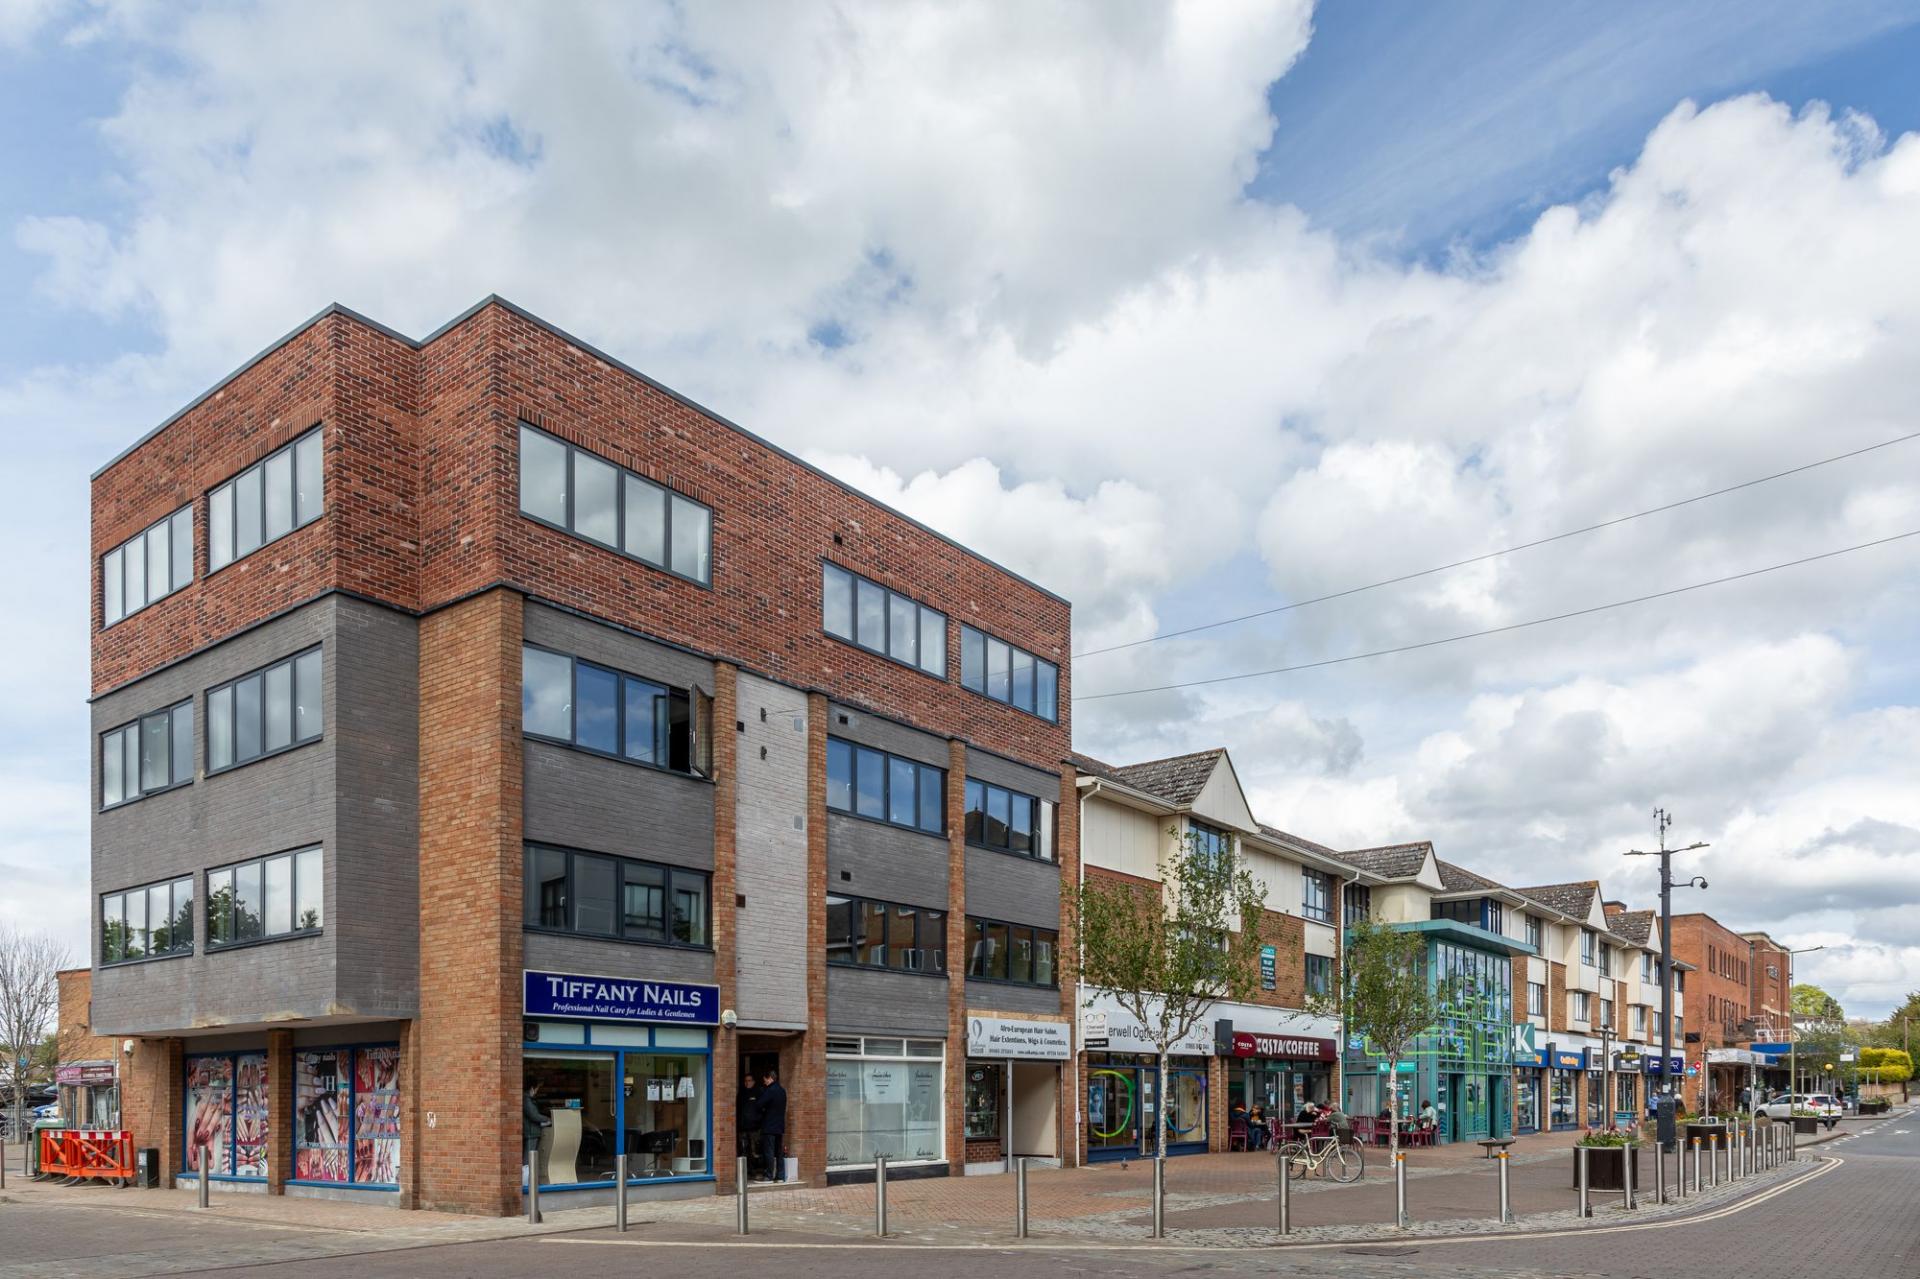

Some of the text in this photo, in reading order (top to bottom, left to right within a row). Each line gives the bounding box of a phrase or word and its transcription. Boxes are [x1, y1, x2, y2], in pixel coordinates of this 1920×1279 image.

[546, 977, 702, 1007] TIFFANY NAILS
[552, 1002, 695, 1018] Professional Nail Care for Ladies & Gentlemen
[1000, 1025, 1033, 1034] Afro-European
[1108, 1025, 1132, 1038] erwell
[990, 1034, 1000, 1042] Hair
[1028, 1037, 1039, 1046] Wigs
[1256, 1038, 1320, 1056] COSTA COFFEE
